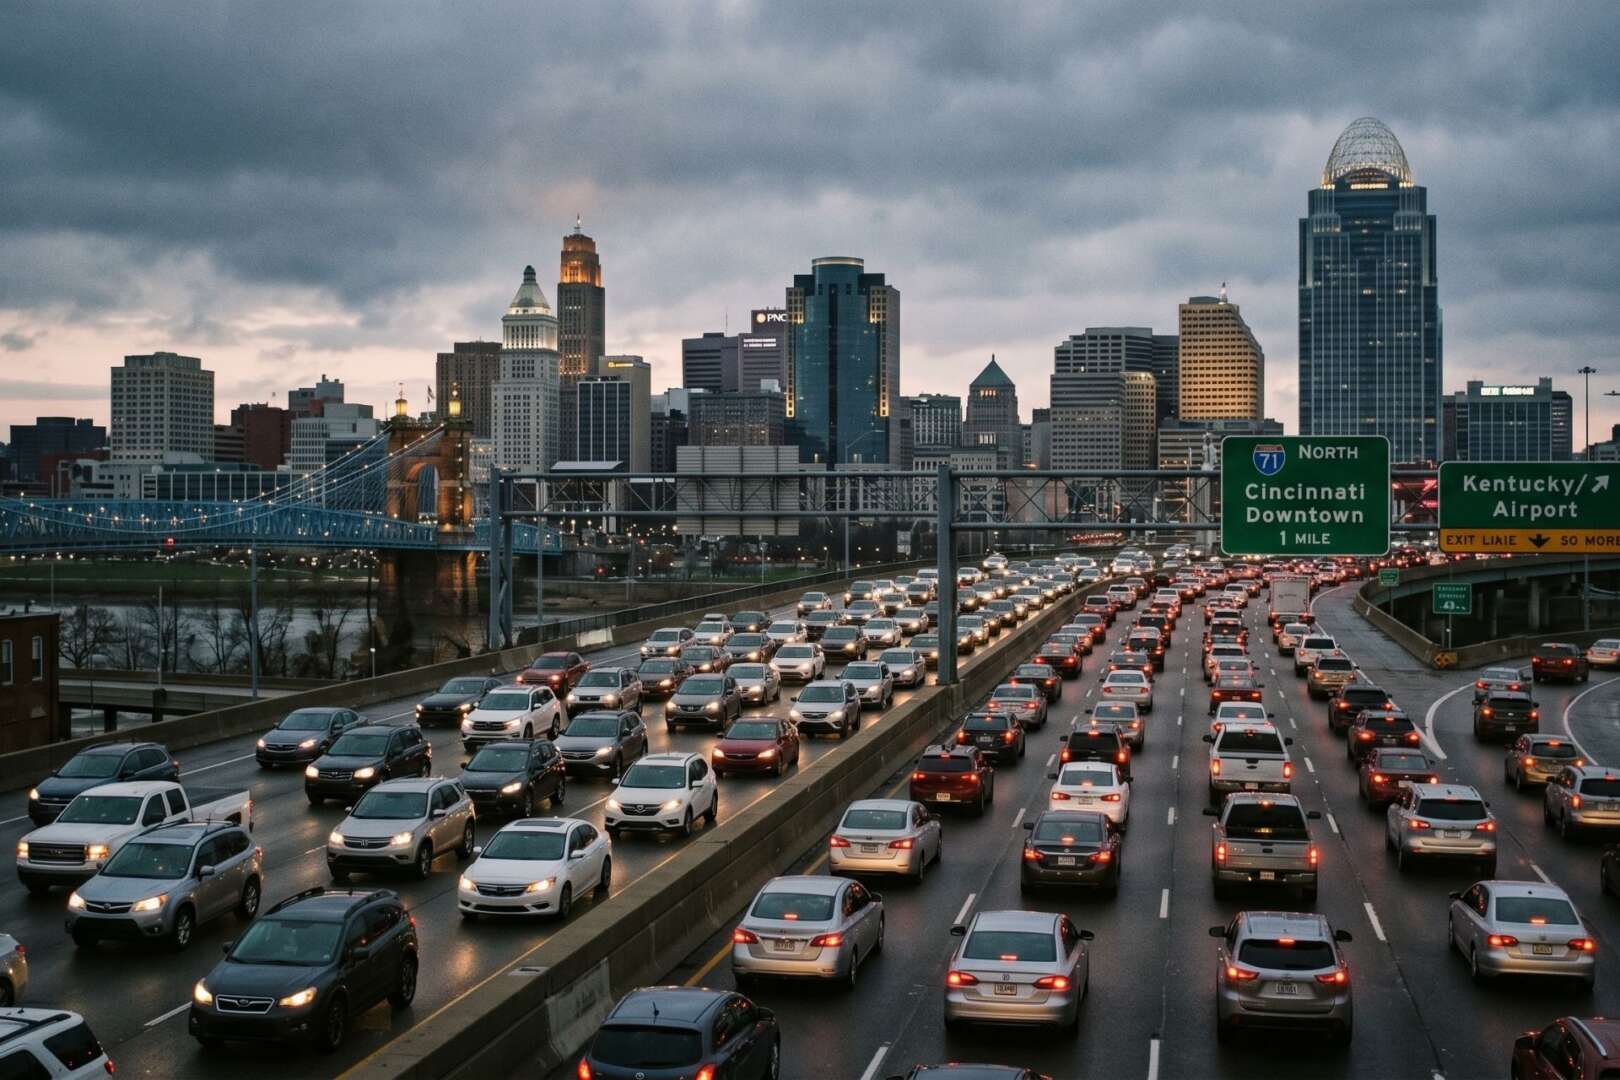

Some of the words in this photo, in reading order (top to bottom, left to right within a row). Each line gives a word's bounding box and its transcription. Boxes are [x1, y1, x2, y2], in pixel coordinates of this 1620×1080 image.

[767, 313, 787, 322] PNC
[1299, 444, 1358, 459] NORTH
[1259, 454, 1277, 469] 71
[1245, 483, 1365, 500] Cincinnati
[1246, 507, 1364, 523] Downtown
[1492, 501, 1578, 521] Airport
[1280, 530, 1286, 546] 1
[1295, 533, 1331, 545] MILE
[1446, 535, 1475, 546] EXIT
